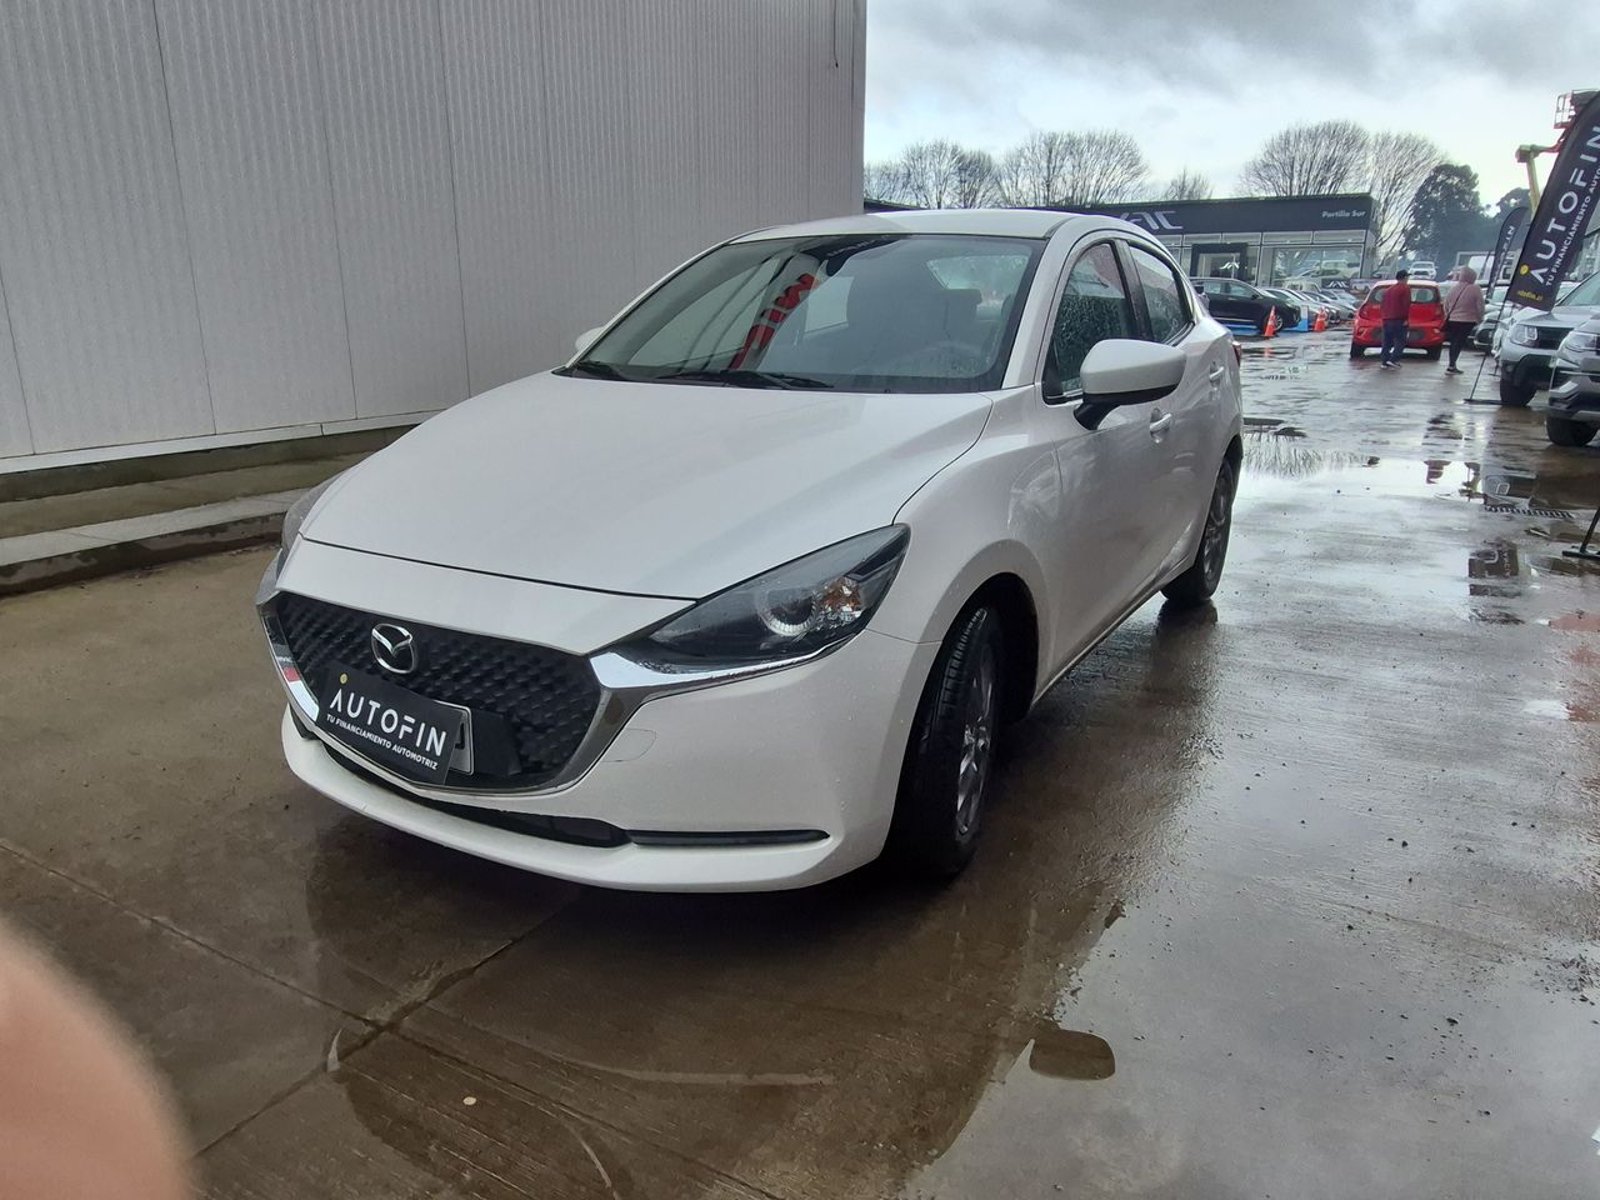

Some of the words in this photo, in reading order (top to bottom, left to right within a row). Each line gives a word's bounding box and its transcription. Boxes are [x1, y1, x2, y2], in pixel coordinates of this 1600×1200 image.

[1545, 274, 1555, 287] TU
[1551, 195, 1591, 274] FINANCIAMIENTO
[326, 713, 336, 724] TU
[335, 716, 392, 749] FINANCIAMIENTO
[392, 744, 438, 770] AUTOMOTRIZ
[330, 688, 447, 757] AUTOFIN
